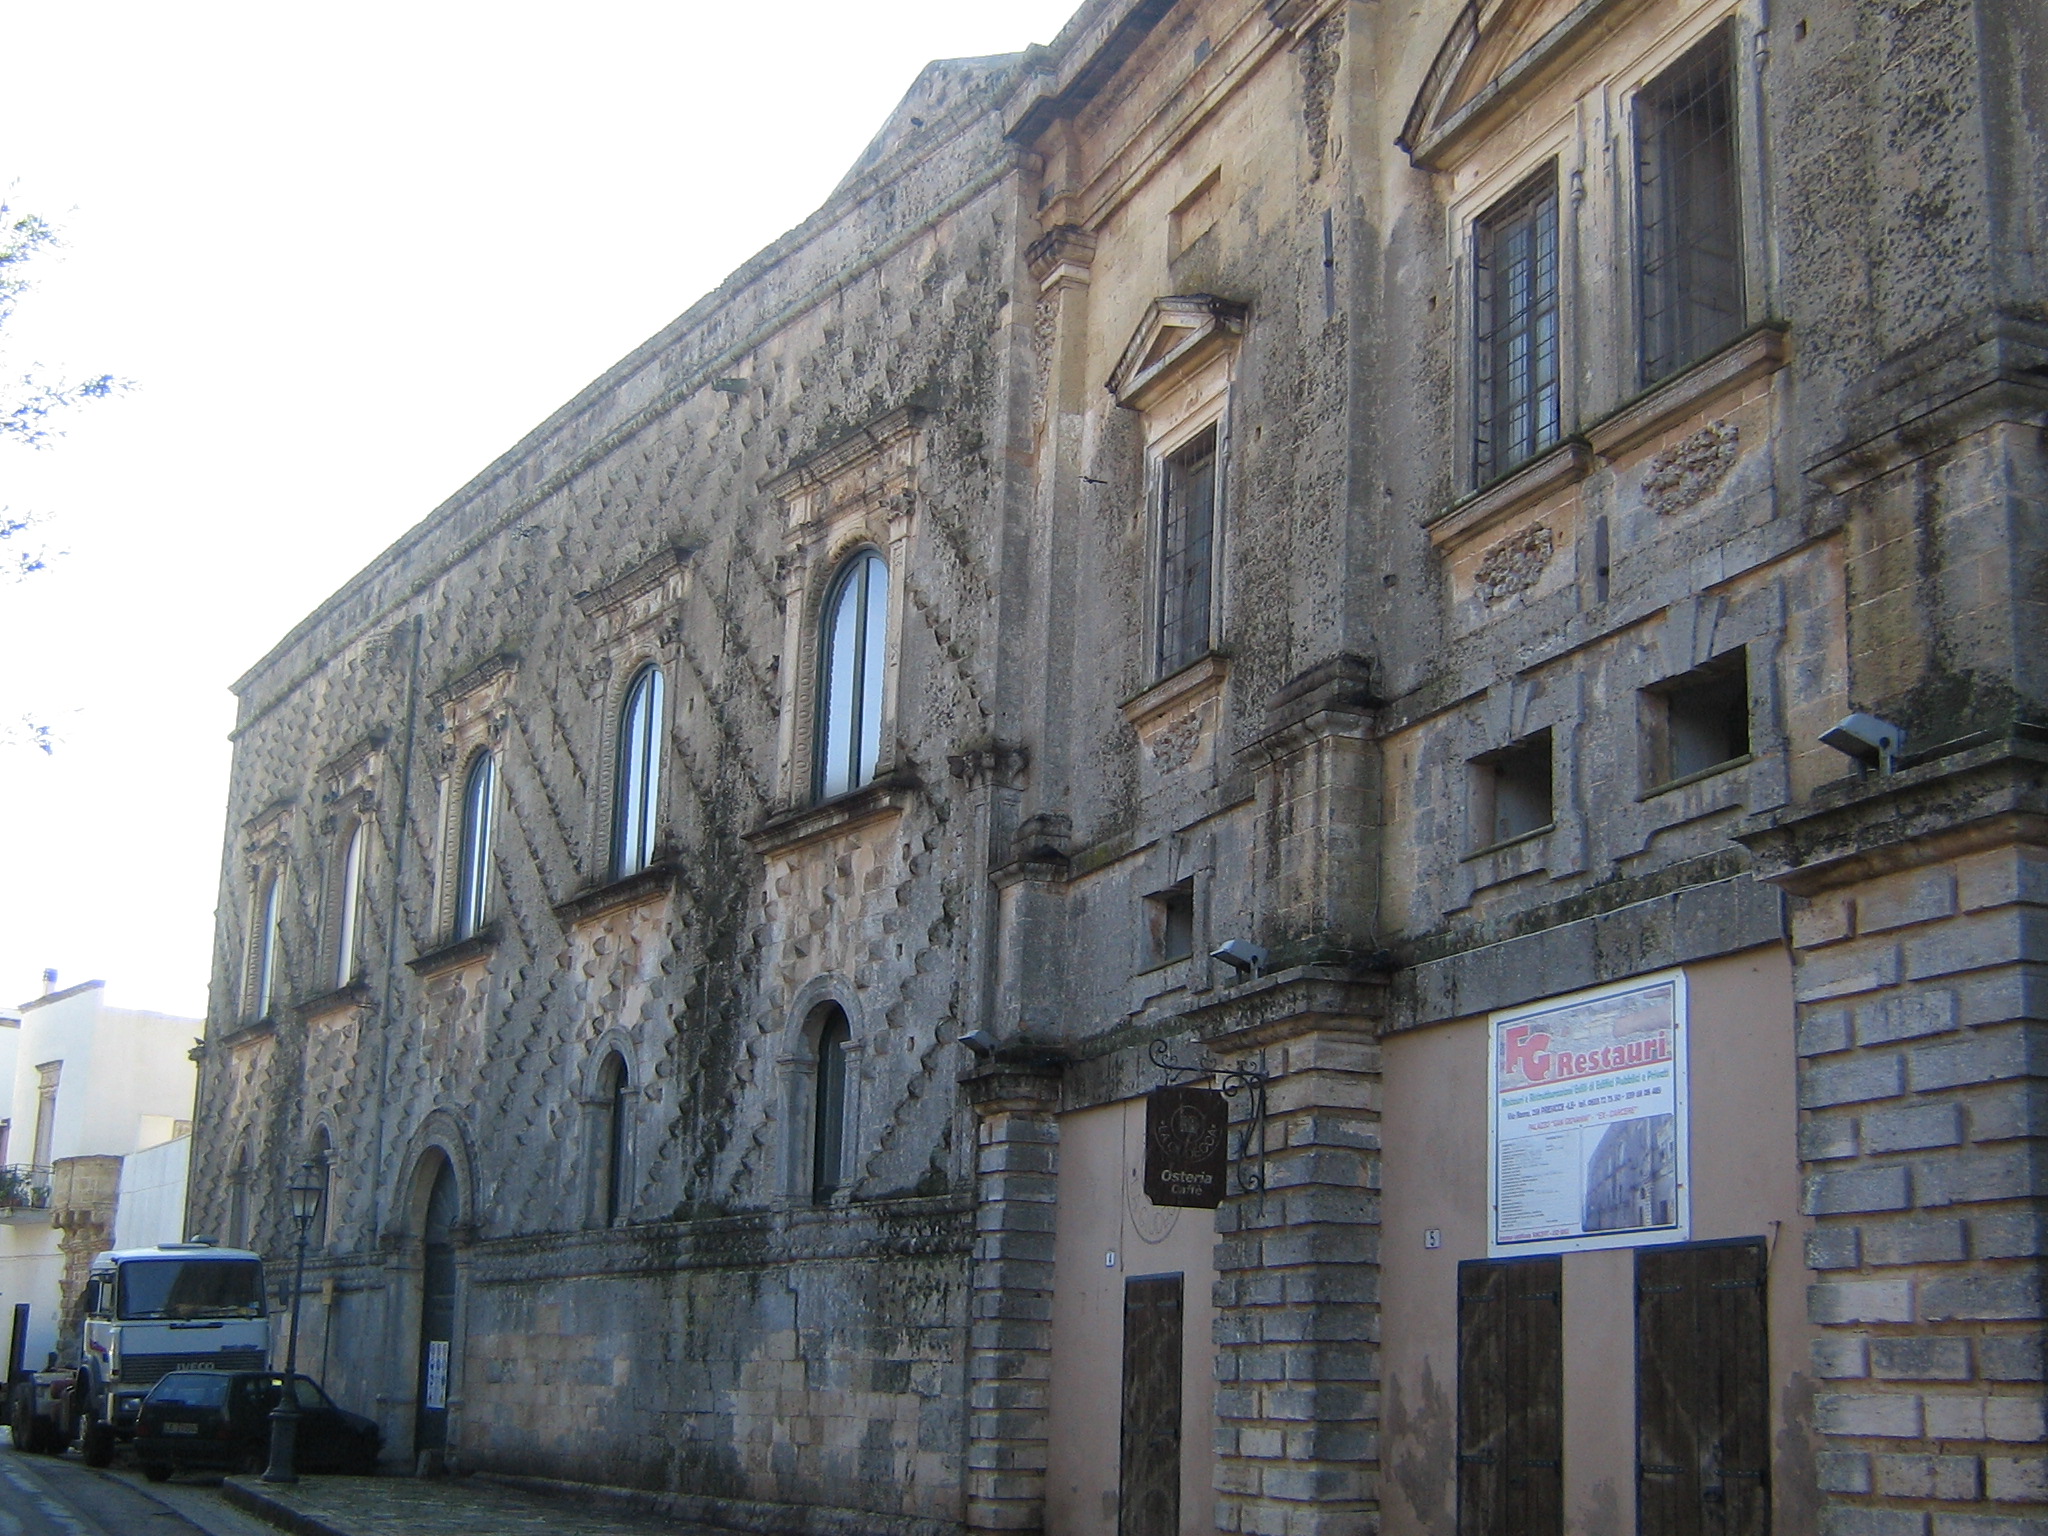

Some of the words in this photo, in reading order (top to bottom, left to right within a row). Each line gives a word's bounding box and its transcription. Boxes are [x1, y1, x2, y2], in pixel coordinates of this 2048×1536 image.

[1557, 1031, 1667, 1077] Restauri
[1161, 1169, 1213, 1184] Osteria
[1430, 1230, 1436, 1247] 5
[177, 1362, 215, 1371] IVECO
